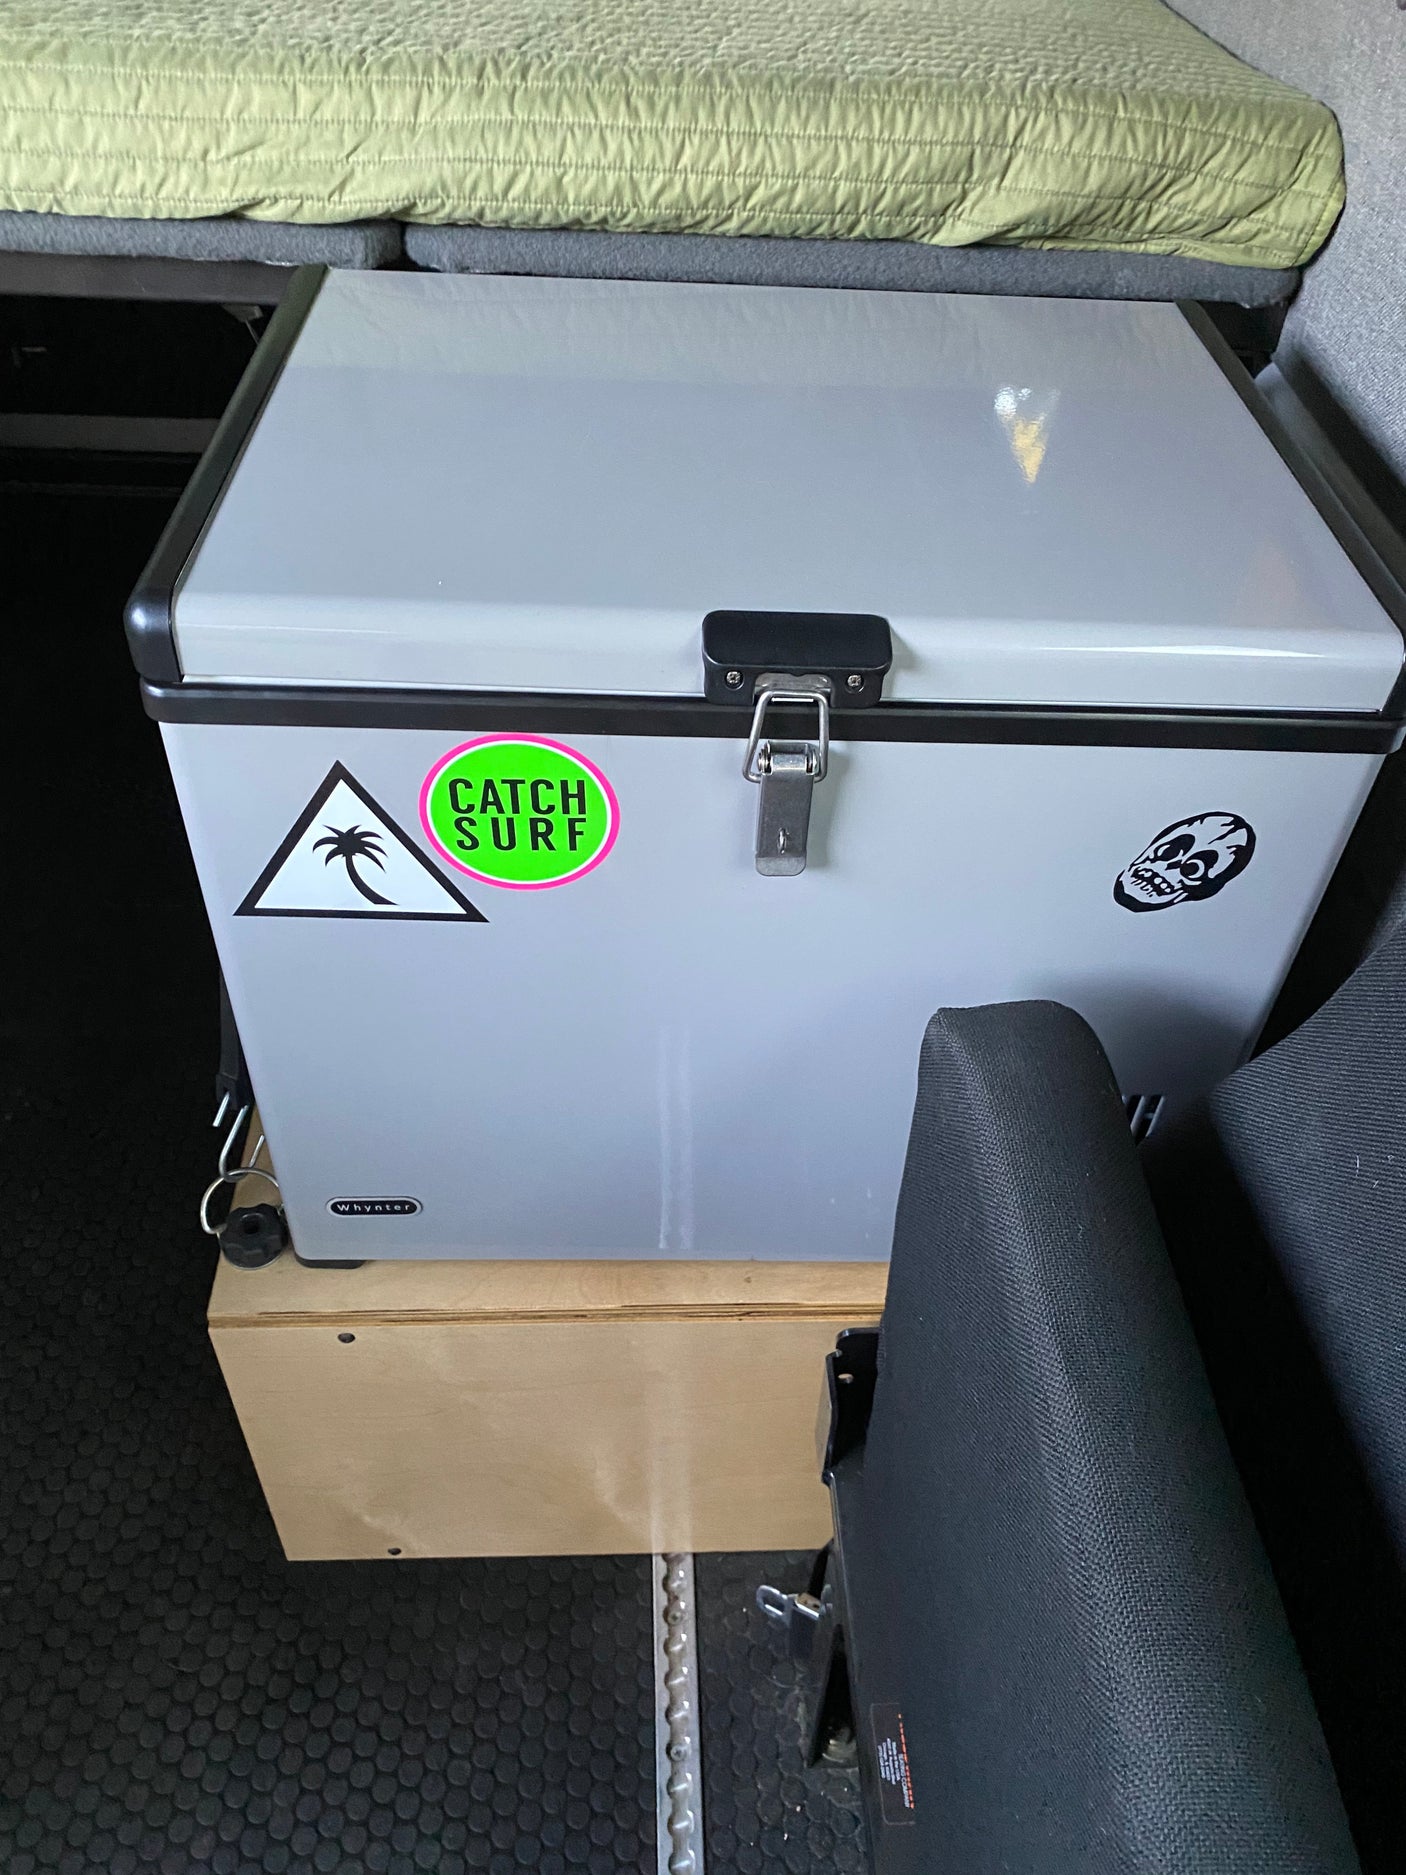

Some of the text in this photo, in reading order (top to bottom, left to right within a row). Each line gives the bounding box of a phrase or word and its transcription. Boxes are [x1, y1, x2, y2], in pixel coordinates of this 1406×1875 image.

[448, 778, 587, 815] CATCH
[453, 816, 587, 852] SURF
[336, 1203, 410, 1212] Whynter
